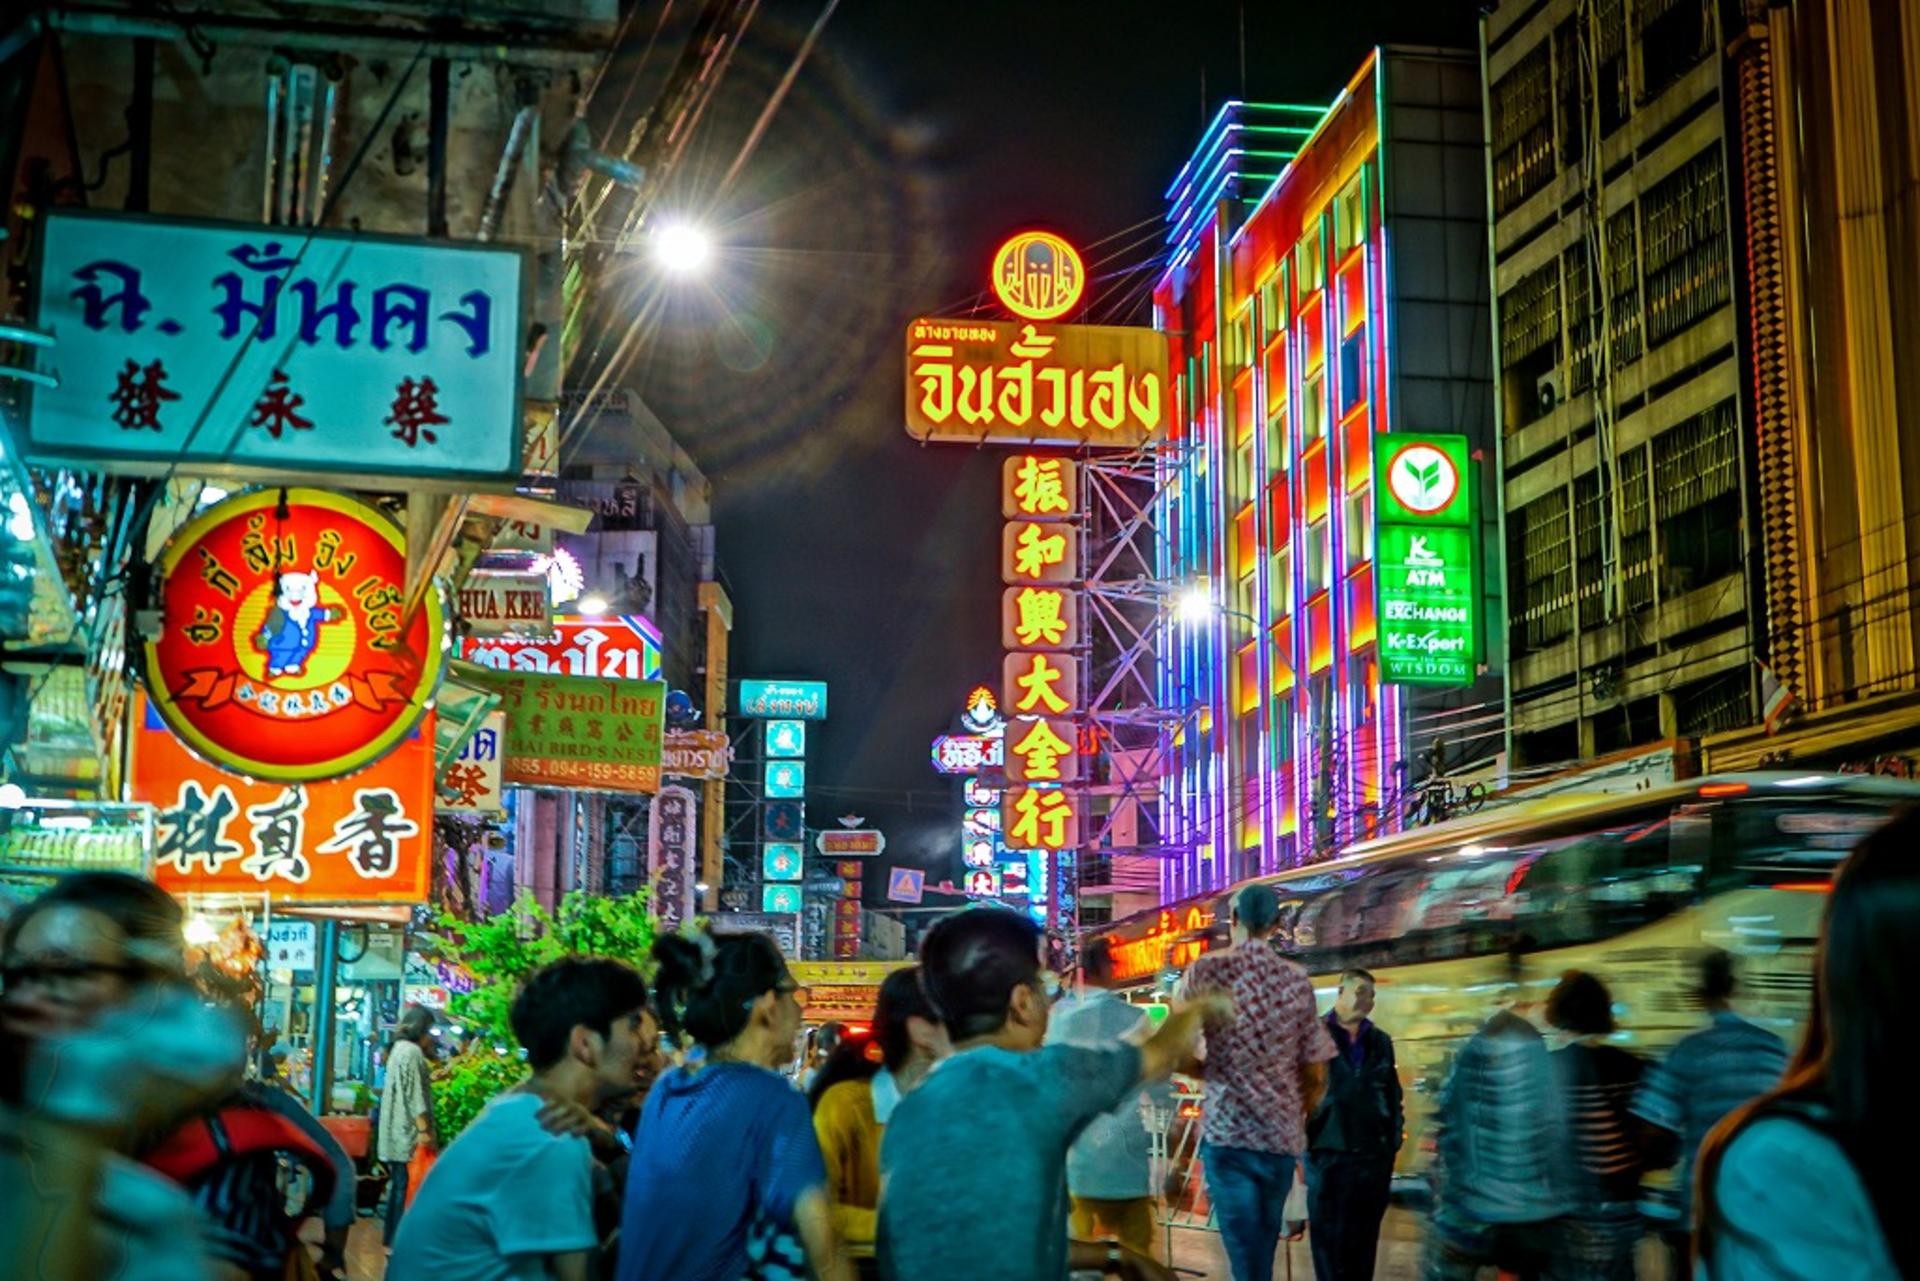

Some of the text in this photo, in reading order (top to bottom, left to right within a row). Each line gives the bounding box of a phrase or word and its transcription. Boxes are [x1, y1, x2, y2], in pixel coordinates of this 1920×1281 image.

[912, 324, 1161, 430] จินฮั้วเฮง
[1406, 569, 1446, 587] ATM
[458, 590, 544, 620] HUA KEE
[1385, 605, 1467, 622] EXCHANGE
[1010, 455, 1073, 848] 振和興大金行
[1390, 662, 1466, 675] WISDOM
[613, 746, 656, 760] NEST
[156, 782, 416, 880] 林真香
